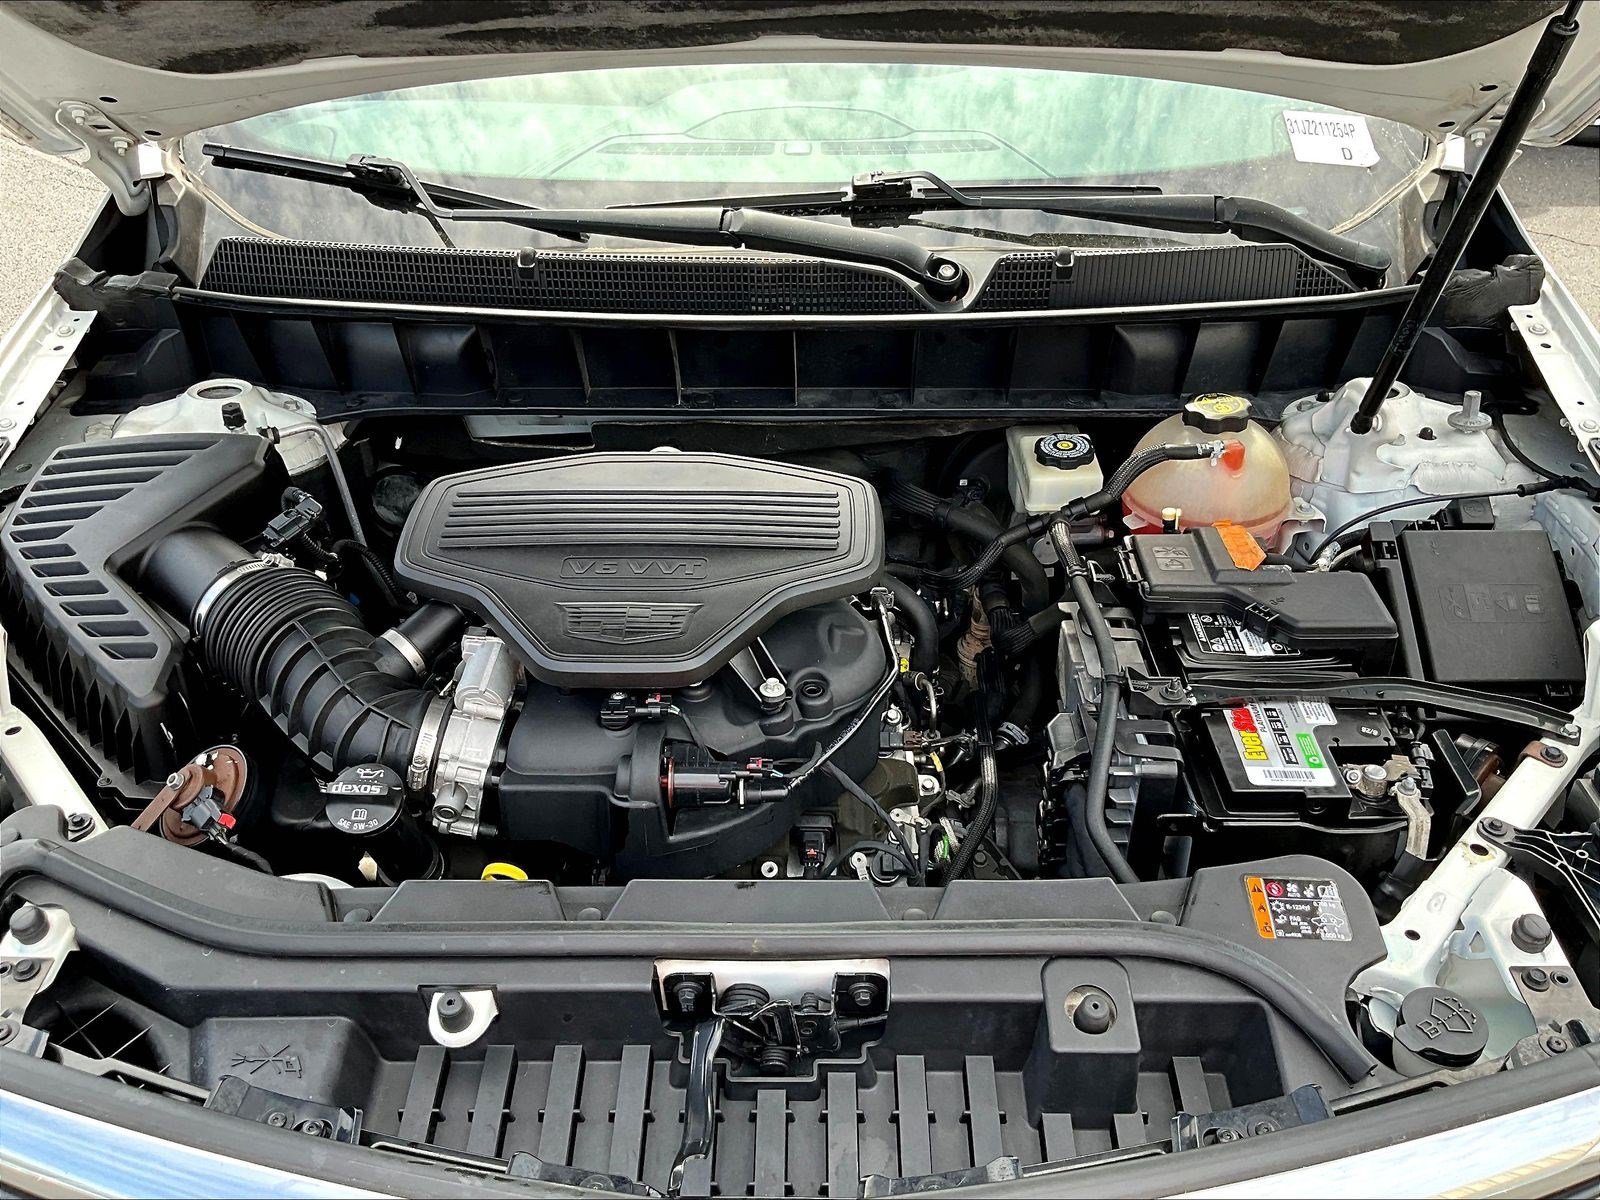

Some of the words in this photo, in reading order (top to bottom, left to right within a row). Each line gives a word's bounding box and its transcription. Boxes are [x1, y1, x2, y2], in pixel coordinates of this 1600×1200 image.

[1286, 119, 1356, 139] 31JZ211254P
[1341, 147, 1353, 161] D
[569, 560, 618, 575] V6
[626, 560, 702, 575] VVT
[1231, 708, 1269, 760] EverSta
[331, 782, 383, 795] dexos
[337, 818, 351, 829] SAE
[353, 818, 379, 830] 5W-30
